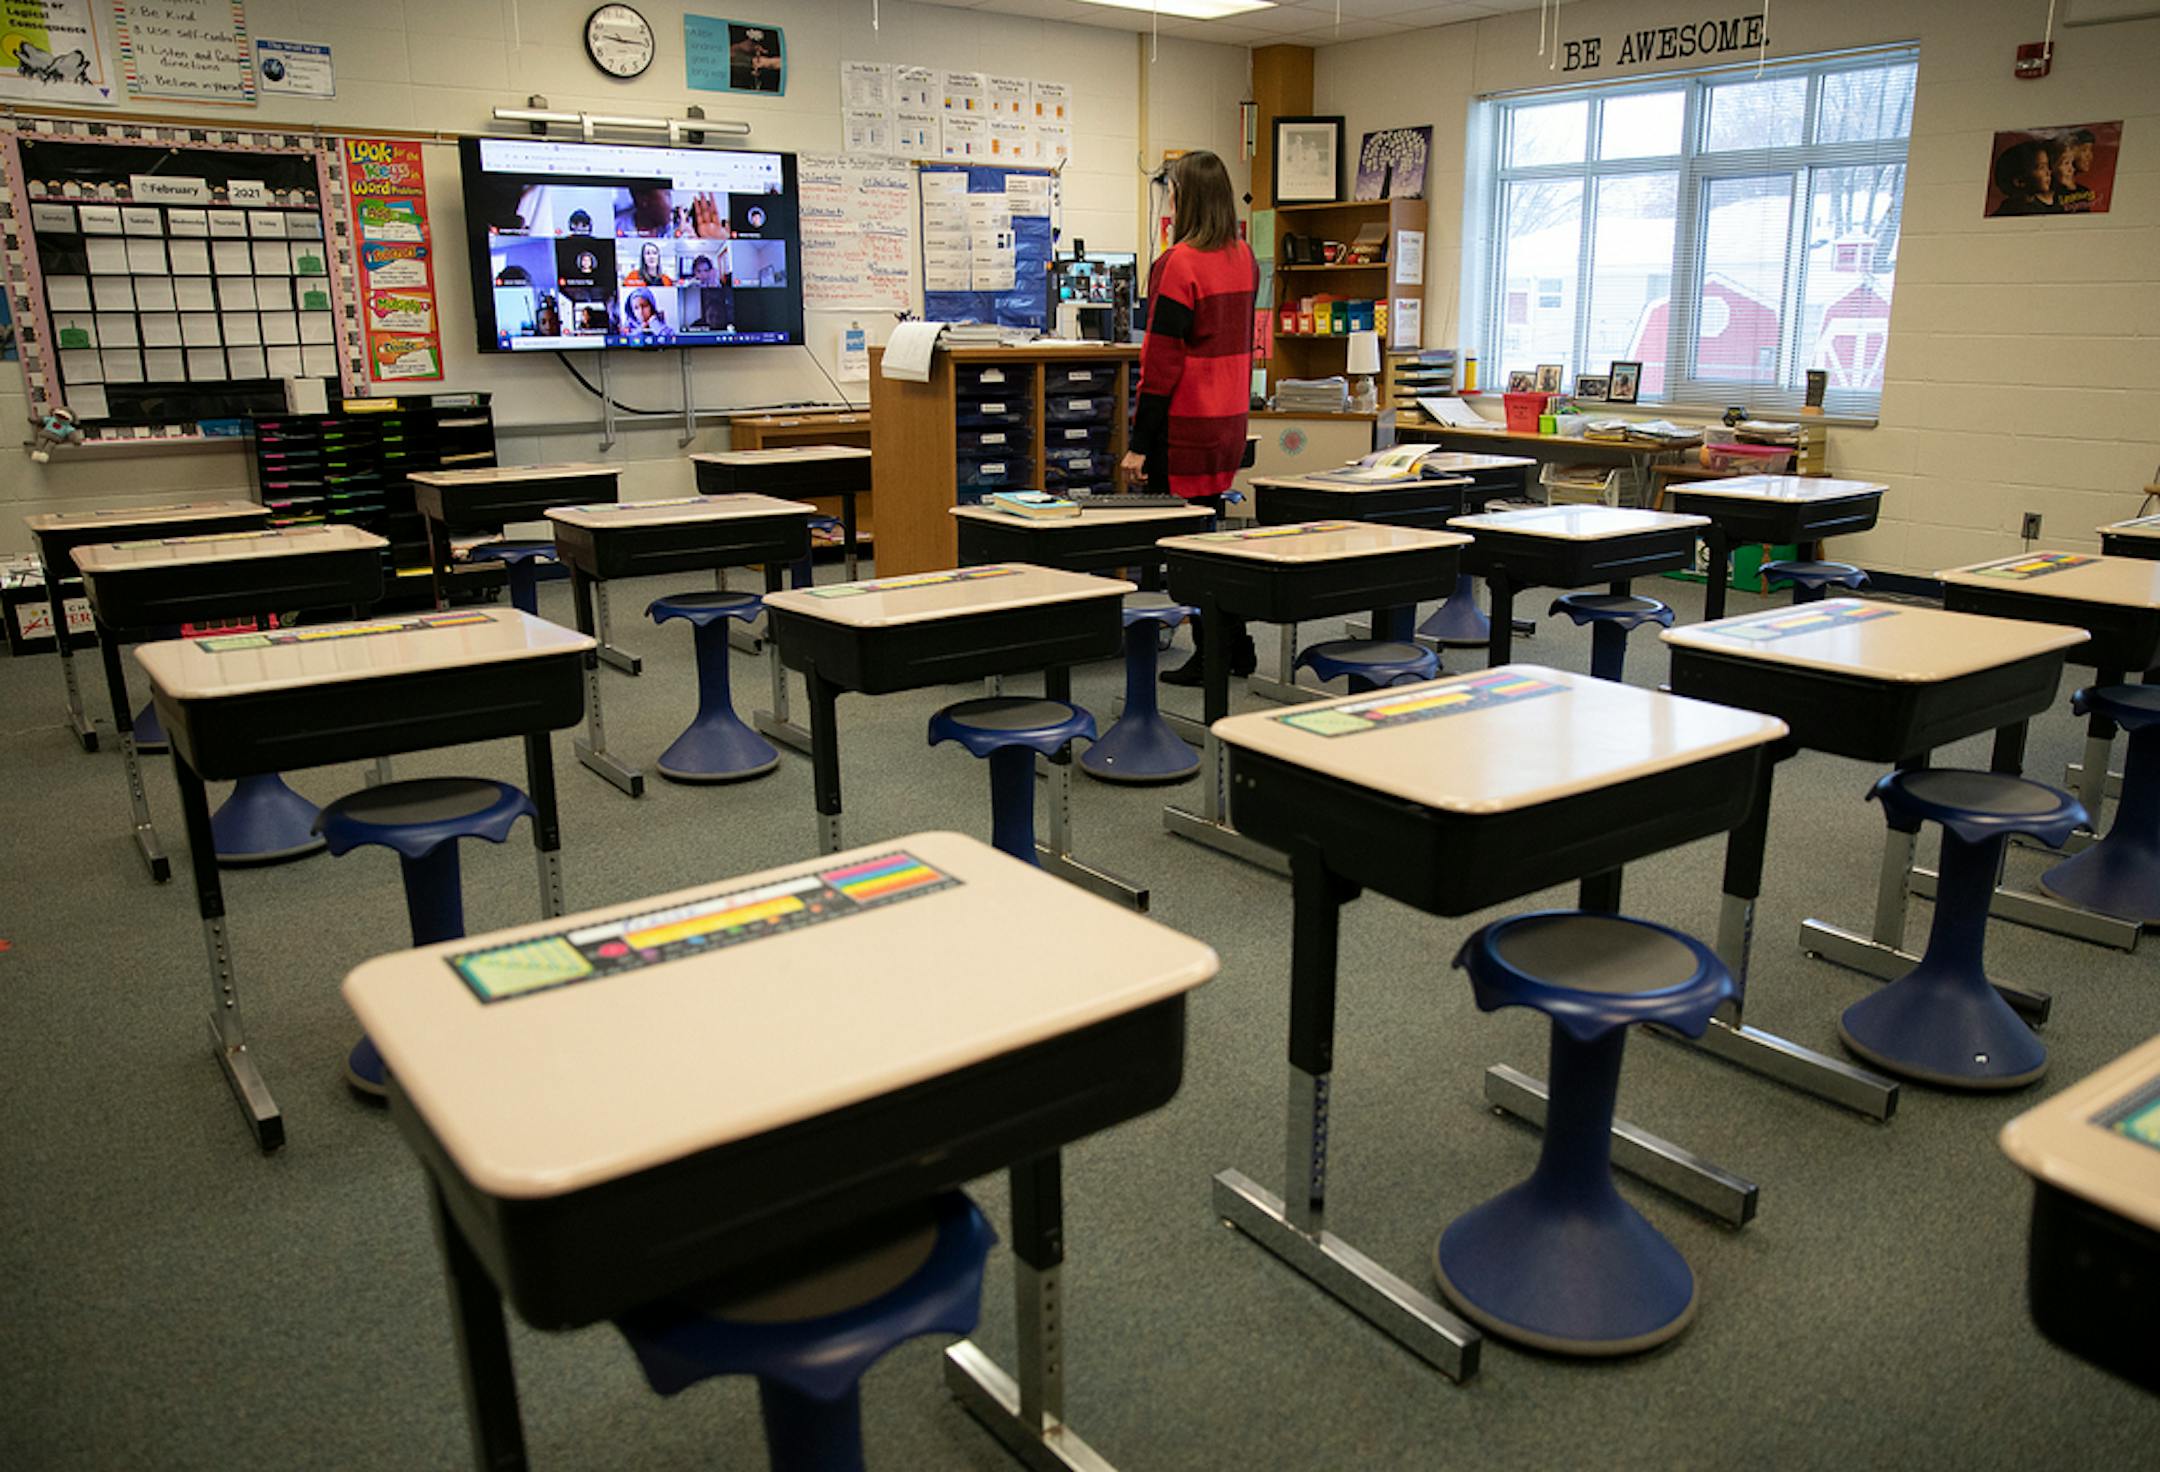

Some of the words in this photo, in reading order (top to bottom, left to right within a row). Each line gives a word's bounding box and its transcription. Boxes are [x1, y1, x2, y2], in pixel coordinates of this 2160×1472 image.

[8, 19, 87, 34] Consequence
[1563, 38, 1600, 71] BE
[1616, 14, 1770, 65] AWESOME.
[151, 46, 188, 59] Listen
[347, 140, 393, 164] Look
[362, 163, 410, 183] Keys
[150, 181, 199, 196] February
[233, 187, 260, 199] 2021
[351, 180, 391, 196] Word
